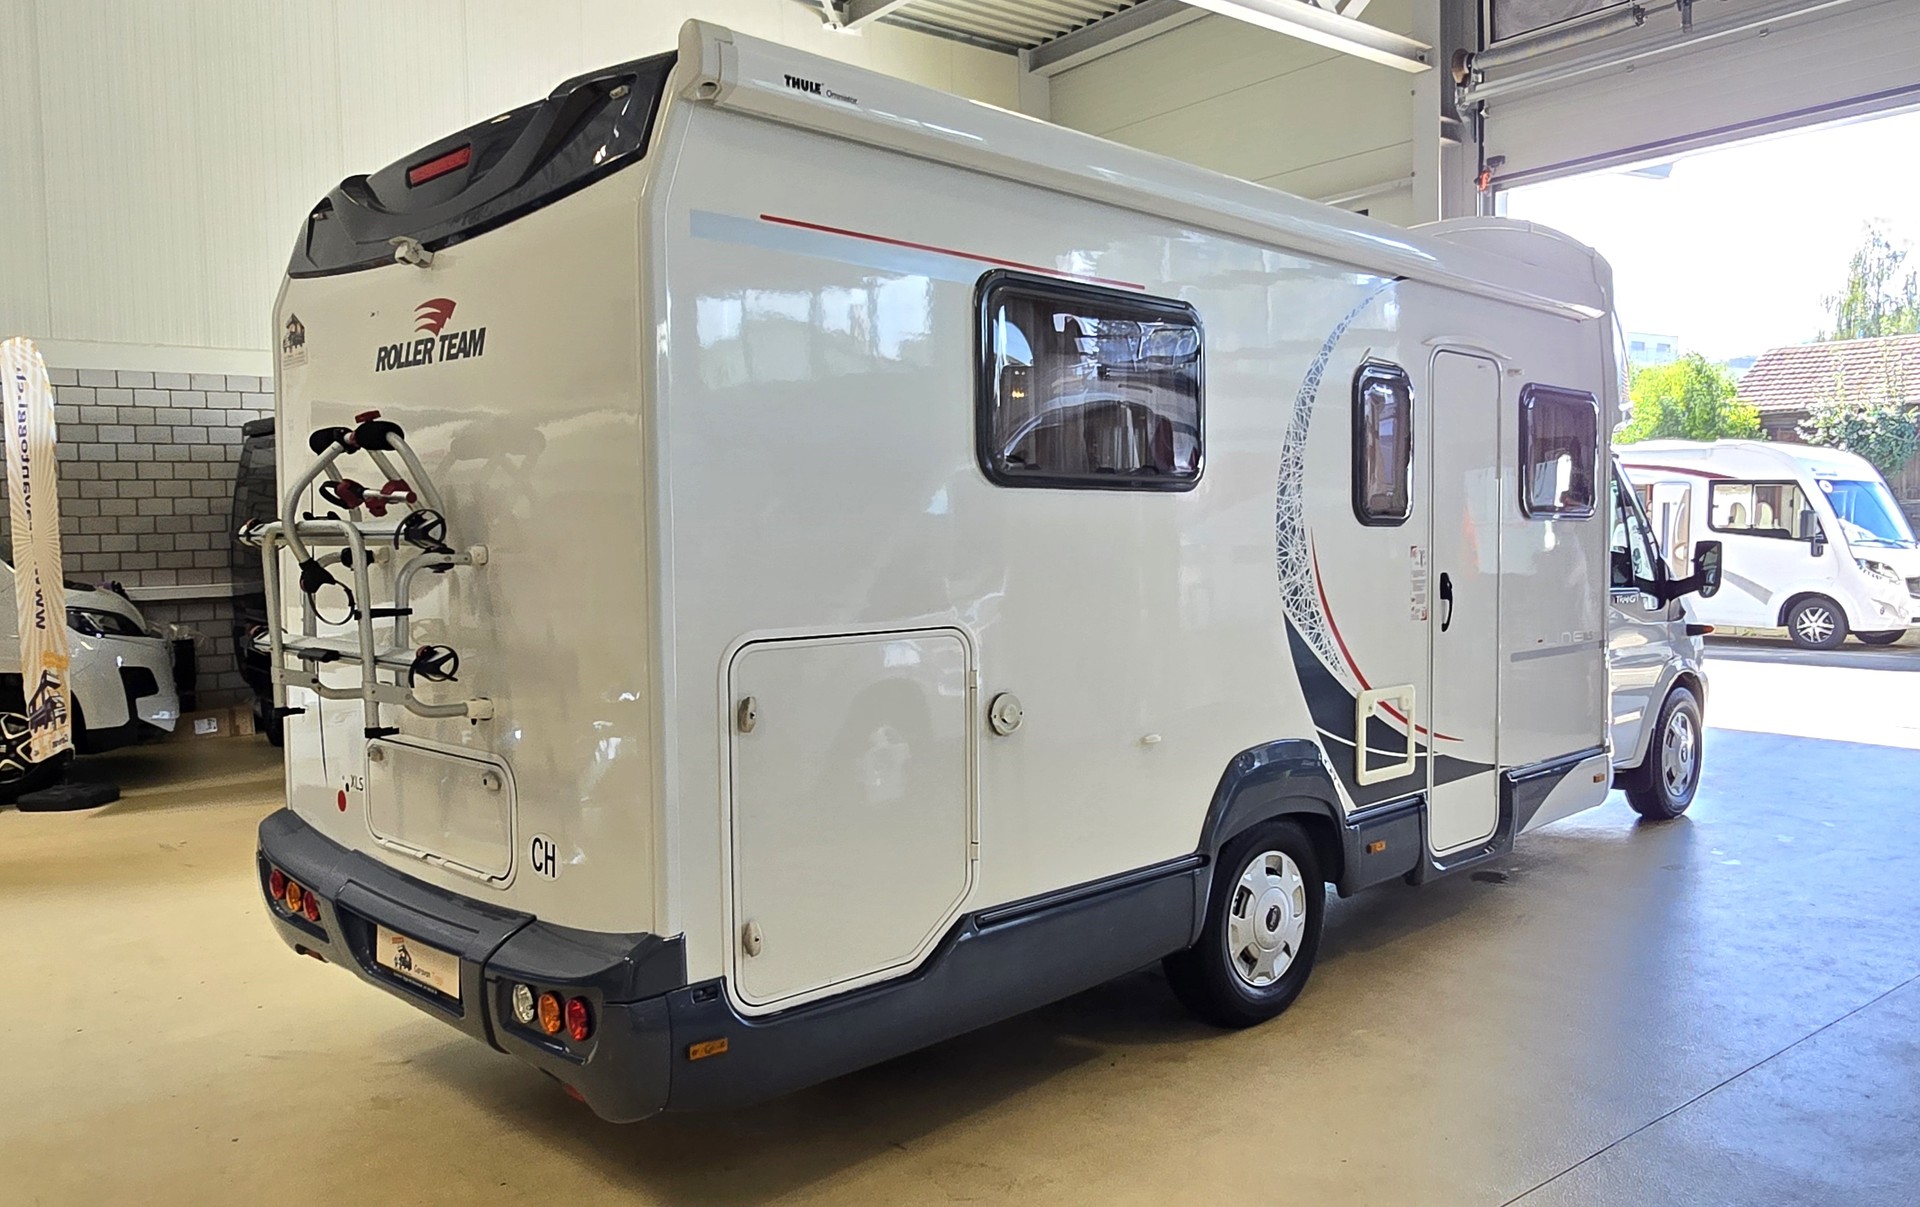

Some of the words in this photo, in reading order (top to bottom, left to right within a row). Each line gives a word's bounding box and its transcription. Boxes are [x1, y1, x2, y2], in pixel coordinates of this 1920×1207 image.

[784, 74, 822, 95] THULE
[376, 337, 436, 372] ROLLER
[439, 327, 486, 362] TEAM
[532, 837, 556, 878] CH
